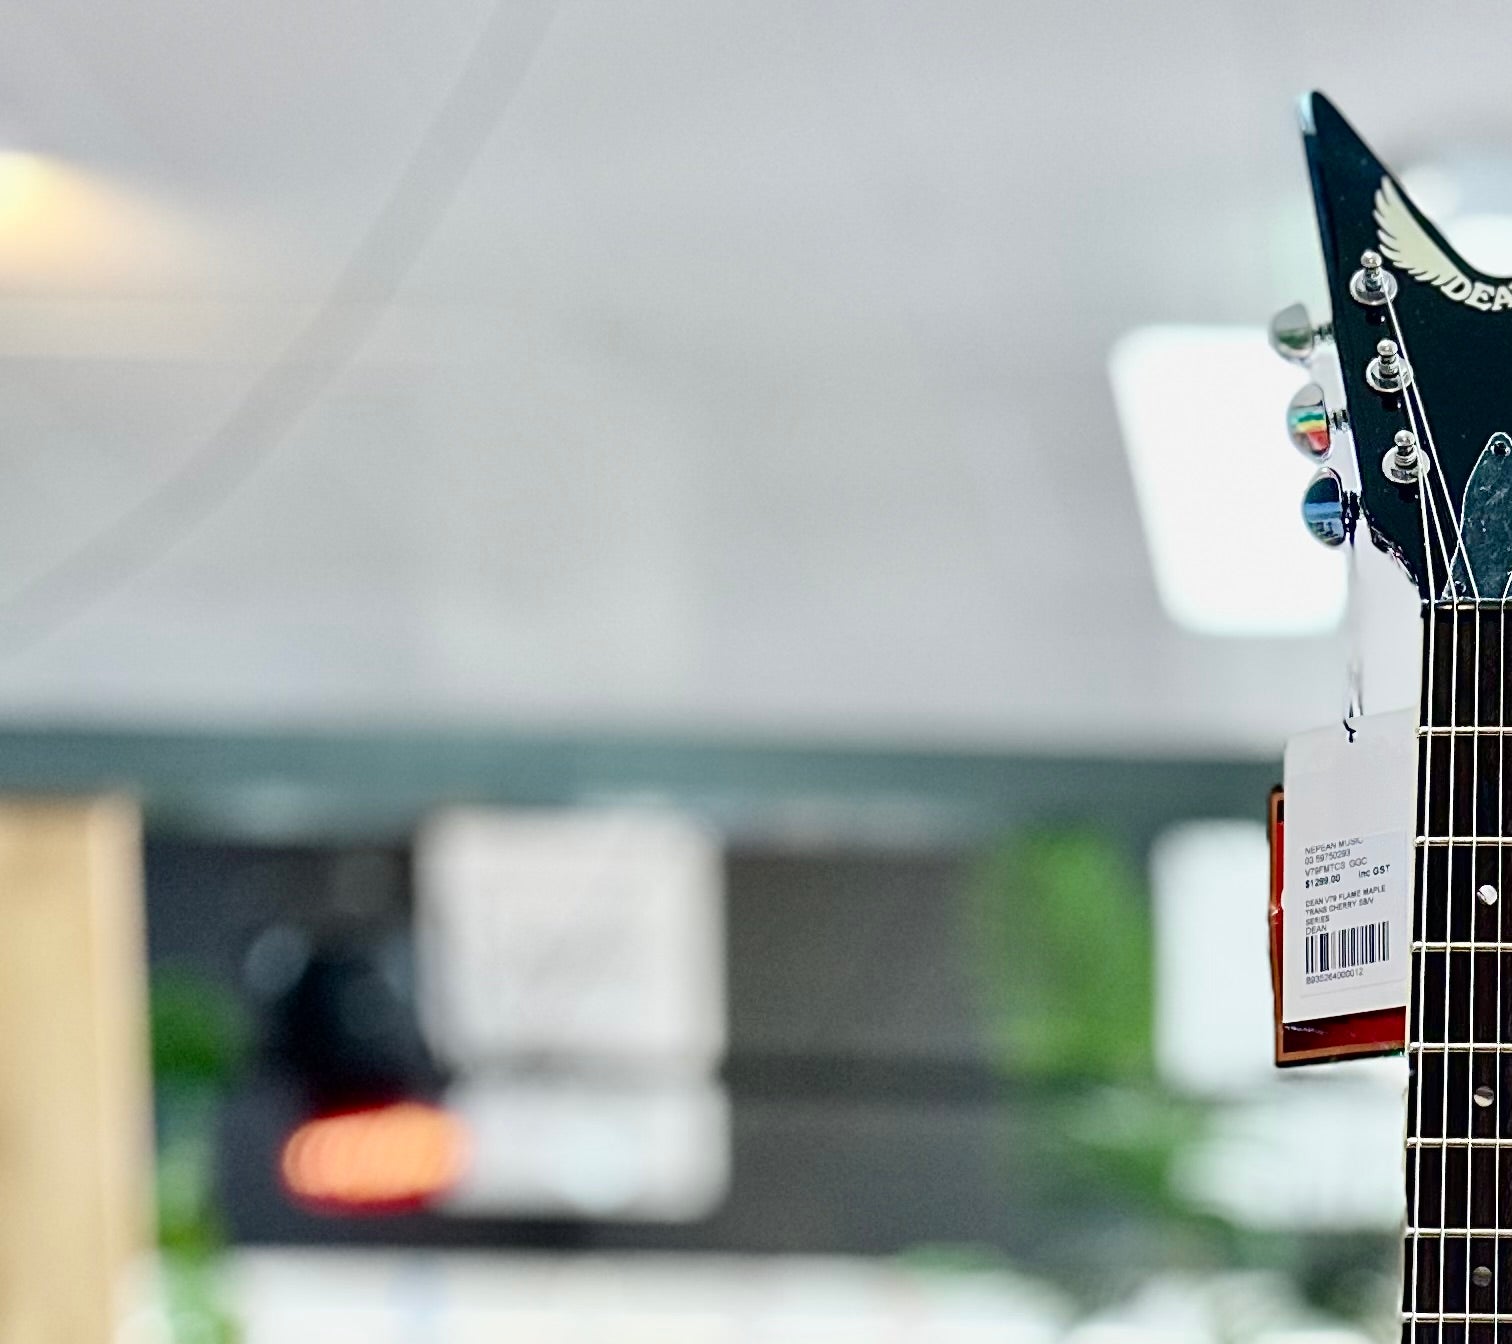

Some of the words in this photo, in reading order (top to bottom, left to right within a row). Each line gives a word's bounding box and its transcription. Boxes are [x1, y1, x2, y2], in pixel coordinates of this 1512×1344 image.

[1304, 843, 1337, 854] NEPEAN
[1363, 884, 1386, 896] MAPLE
[1305, 925, 1327, 936] DEAN
